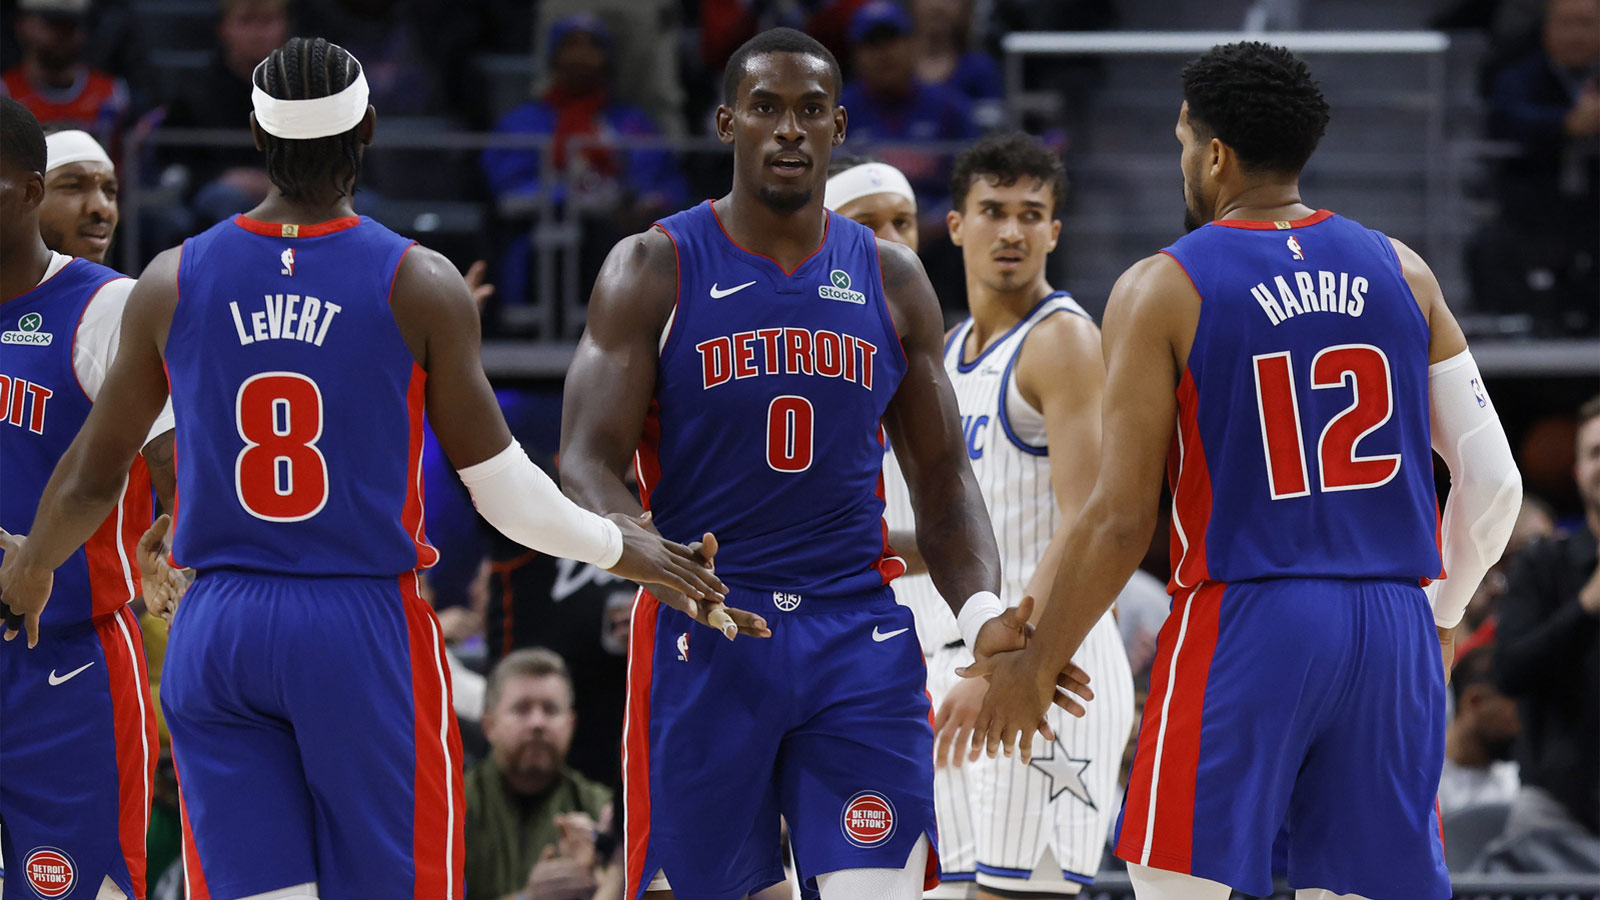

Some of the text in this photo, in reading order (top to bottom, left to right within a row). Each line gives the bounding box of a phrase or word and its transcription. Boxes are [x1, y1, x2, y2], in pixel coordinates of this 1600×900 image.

[820, 287, 865, 303] StockX
[1250, 270, 1368, 326] HARRIS
[2, 332, 51, 344] StockX
[696, 327, 877, 391] DETROIT
[1252, 343, 1402, 500] 12
[766, 395, 814, 473] 0
[235, 371, 329, 522] 8
[852, 810, 886, 819] DETROIT
[851, 819, 886, 828] PISTONS
[32, 864, 65, 874] DETROIT
[33, 873, 66, 882] PISTONS
